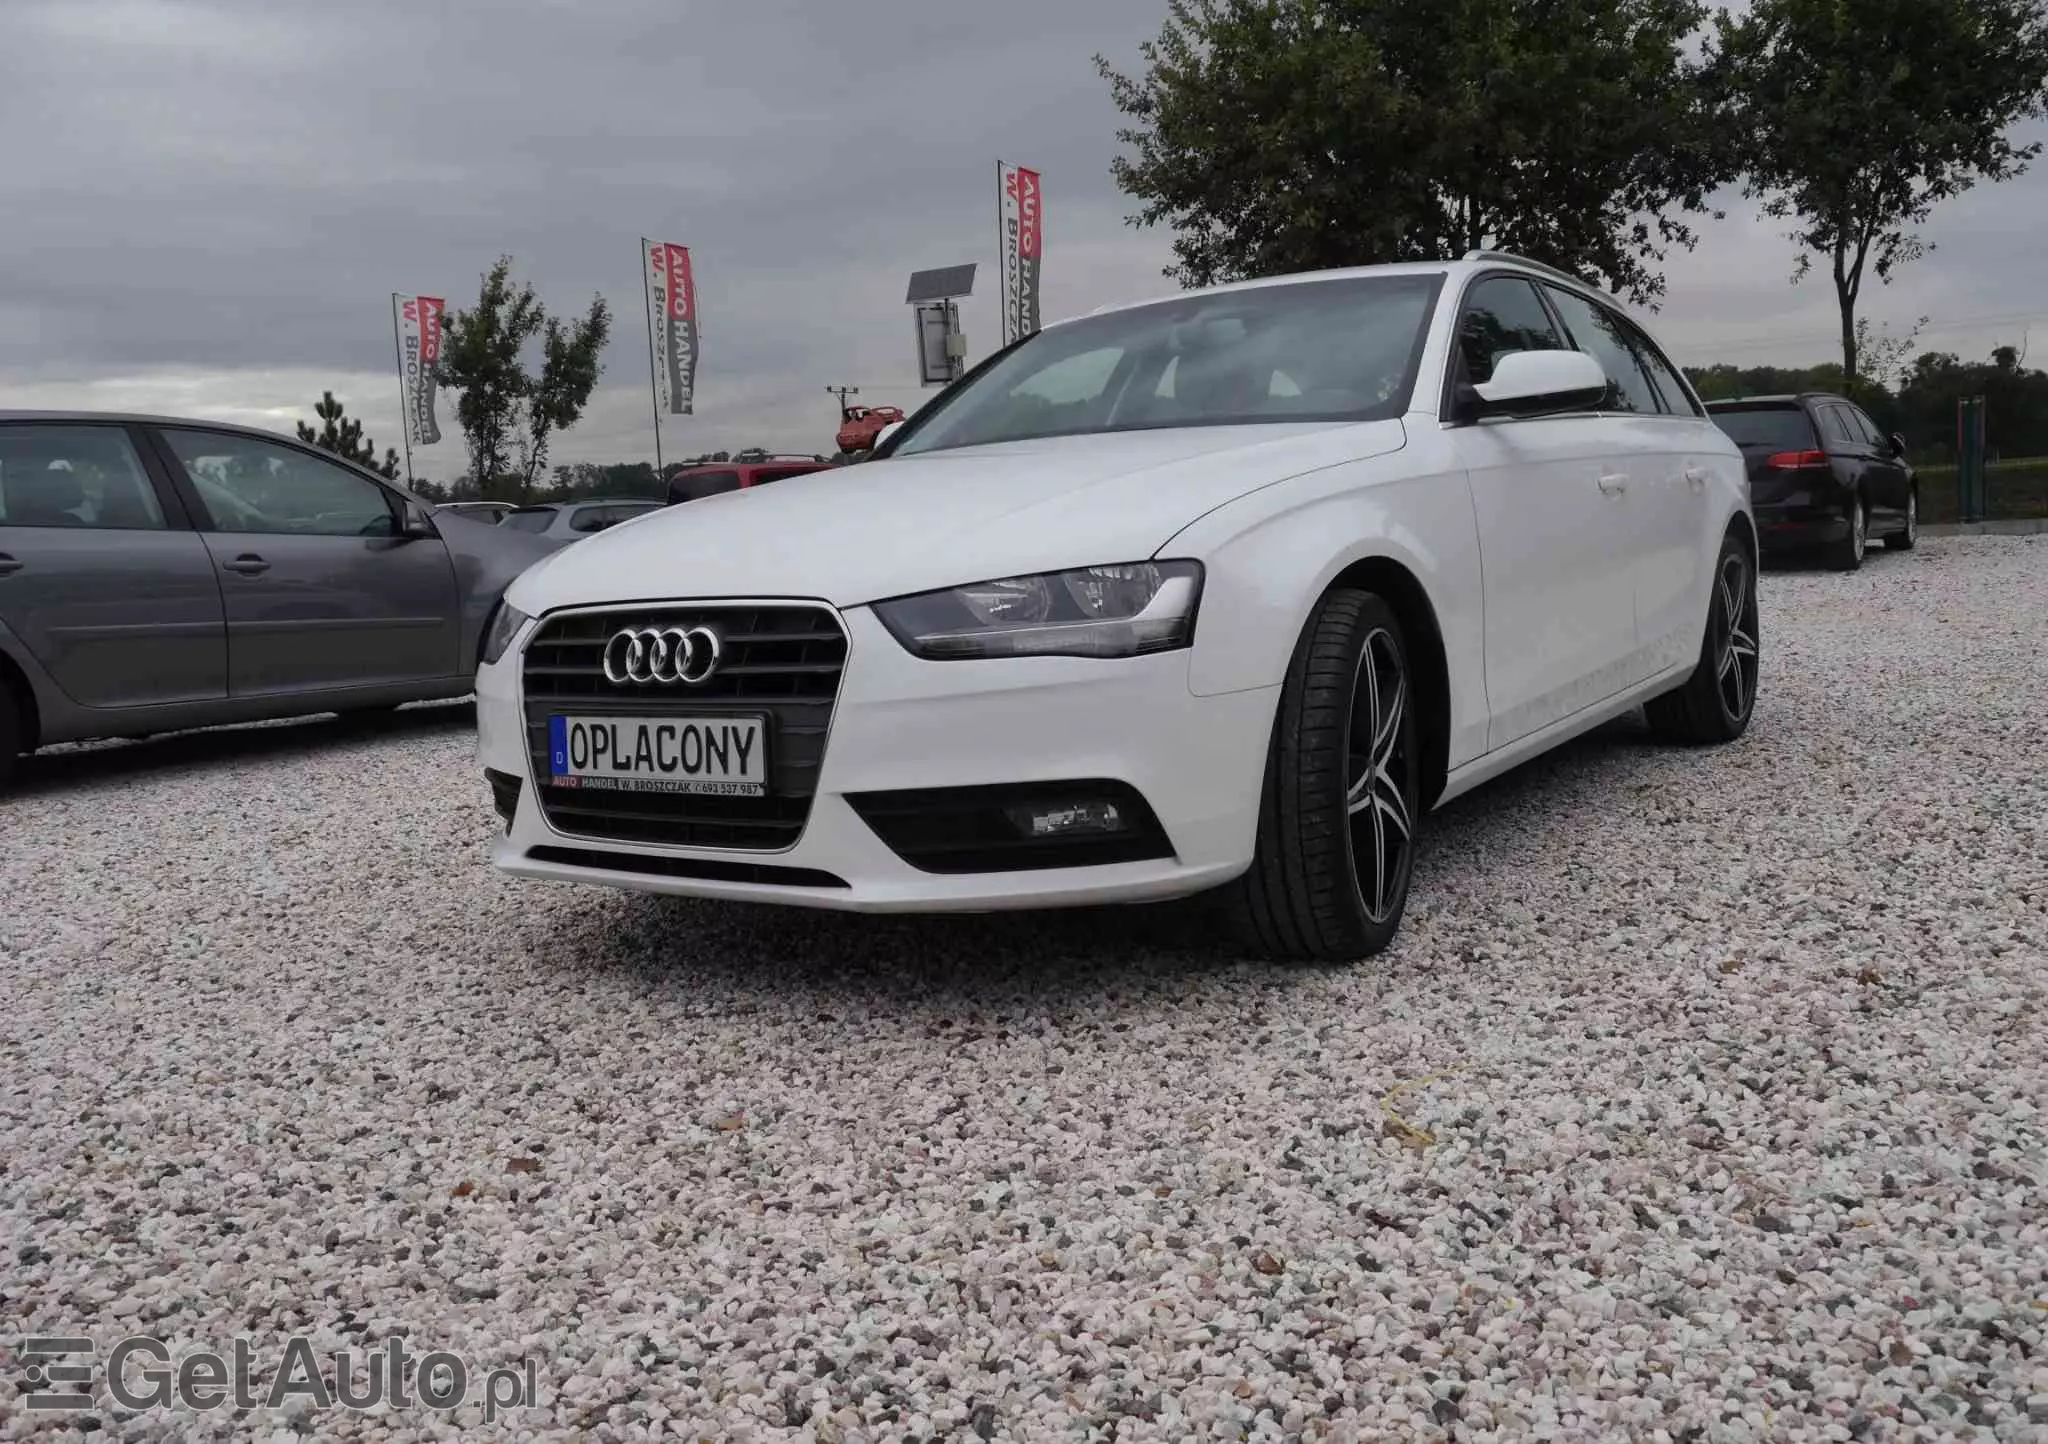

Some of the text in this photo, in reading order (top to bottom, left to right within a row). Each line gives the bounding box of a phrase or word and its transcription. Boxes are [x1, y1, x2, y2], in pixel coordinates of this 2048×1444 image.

[1006, 171, 1019, 208] W.
[1022, 175, 1034, 253] AUTO
[650, 247, 664, 279] W.
[403, 300, 417, 328] W.
[425, 302, 437, 359] AUTO
[669, 248, 693, 414] AUTO HANDEL
[570, 722, 755, 775] OPLACONY
[553, 776, 577, 786] AUTO
[582, 777, 617, 789] HANDEL
[634, 781, 691, 793] BROSZCZAK
